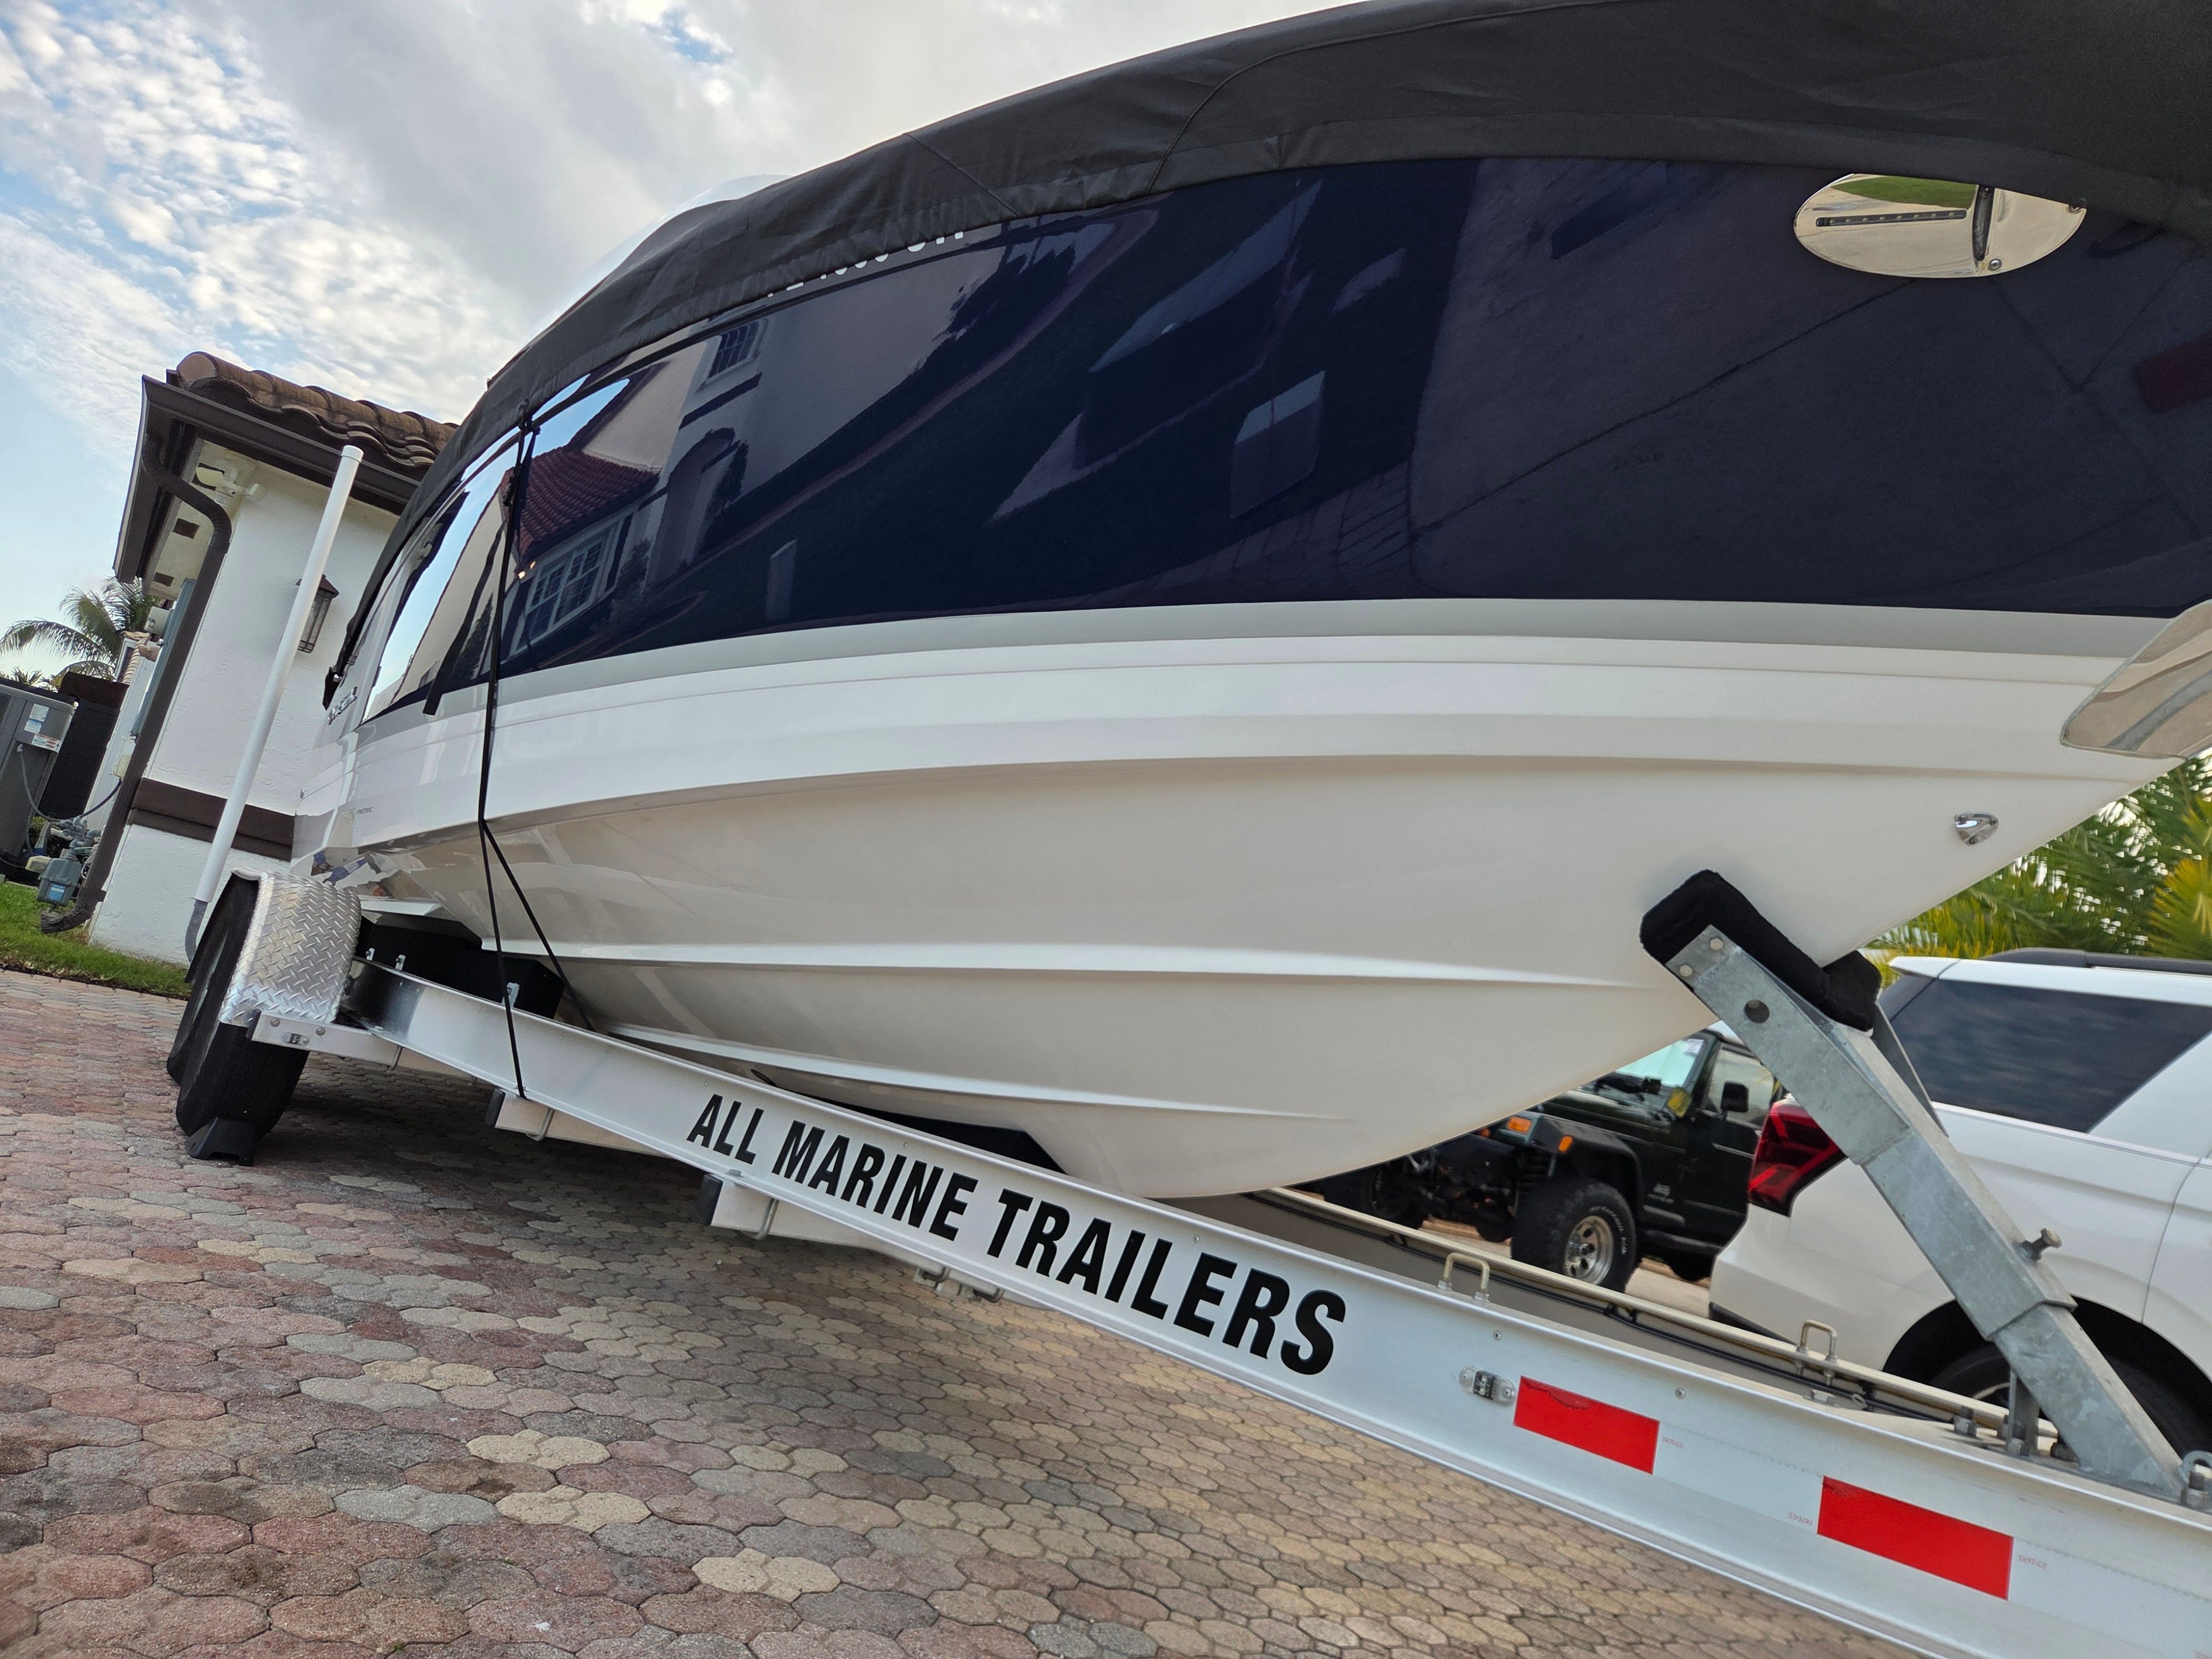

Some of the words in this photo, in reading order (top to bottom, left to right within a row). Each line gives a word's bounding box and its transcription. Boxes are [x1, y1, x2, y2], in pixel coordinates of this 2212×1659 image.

[686, 1093, 764, 1165] ALL
[771, 1120, 978, 1241] MARINE
[987, 1188, 1346, 1375] TRAILERS
